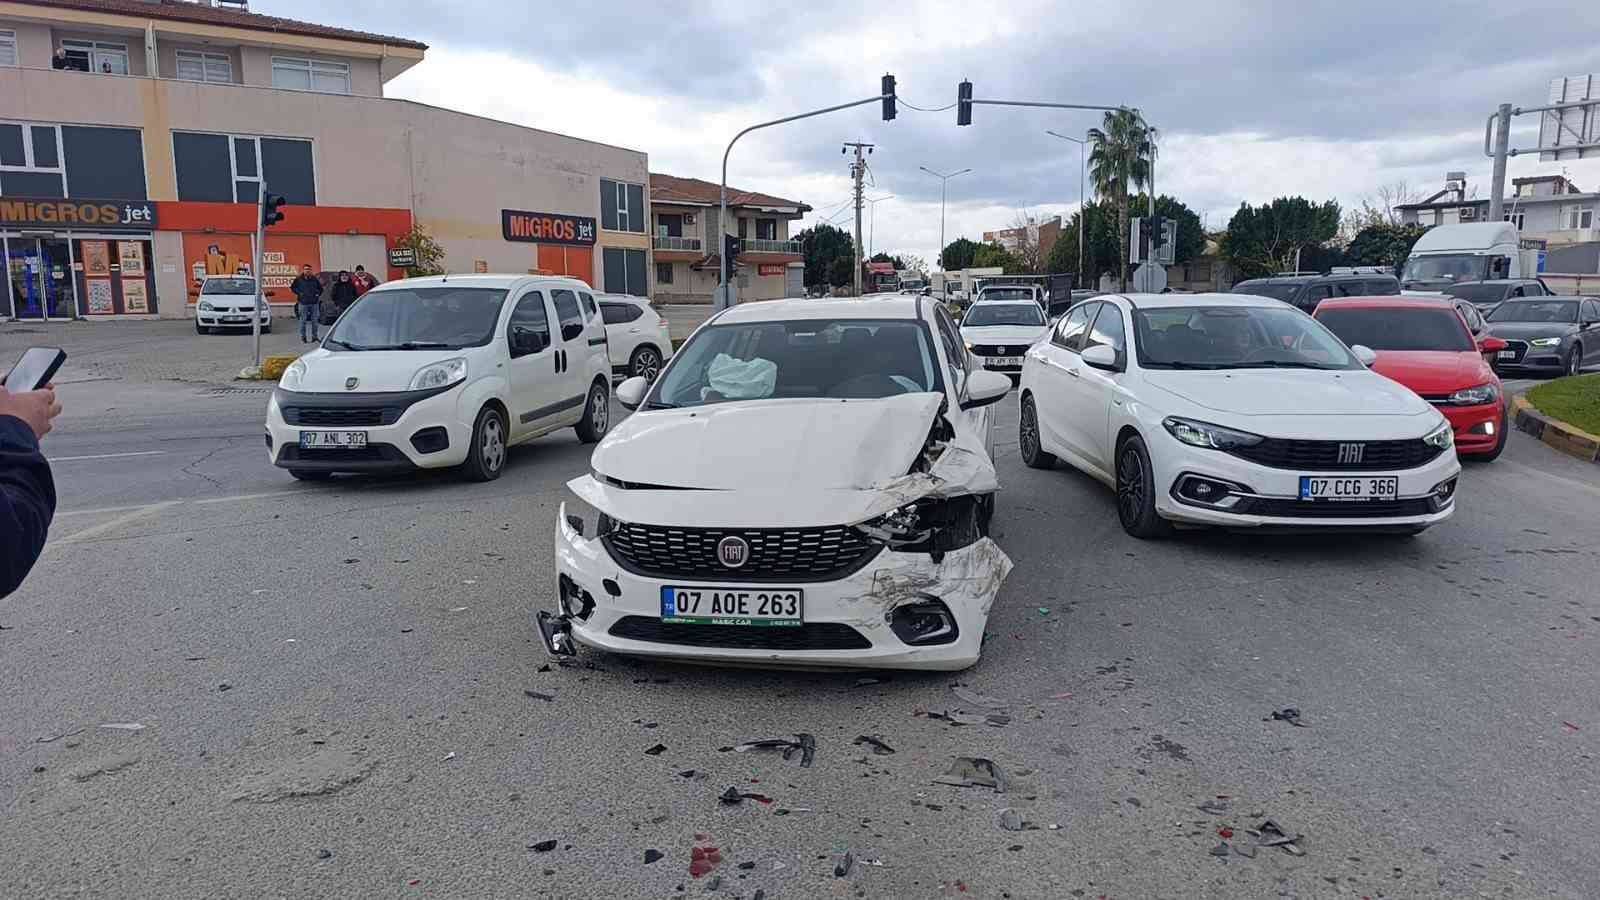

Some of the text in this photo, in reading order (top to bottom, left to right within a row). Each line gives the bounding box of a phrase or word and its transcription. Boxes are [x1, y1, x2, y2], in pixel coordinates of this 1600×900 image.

[121, 204, 151, 224] jet
[577, 220, 592, 240] jet
[305, 432, 318, 444] 07
[346, 432, 364, 444] 302
[1337, 443, 1365, 463] FIAT
[1311, 480, 1328, 495] 07
[1335, 480, 1361, 495] CCG
[1369, 480, 1394, 495] 366
[725, 545, 743, 560] FIAT
[677, 591, 701, 613] 07
[711, 593, 749, 615] AOE
[757, 594, 797, 616] 263
